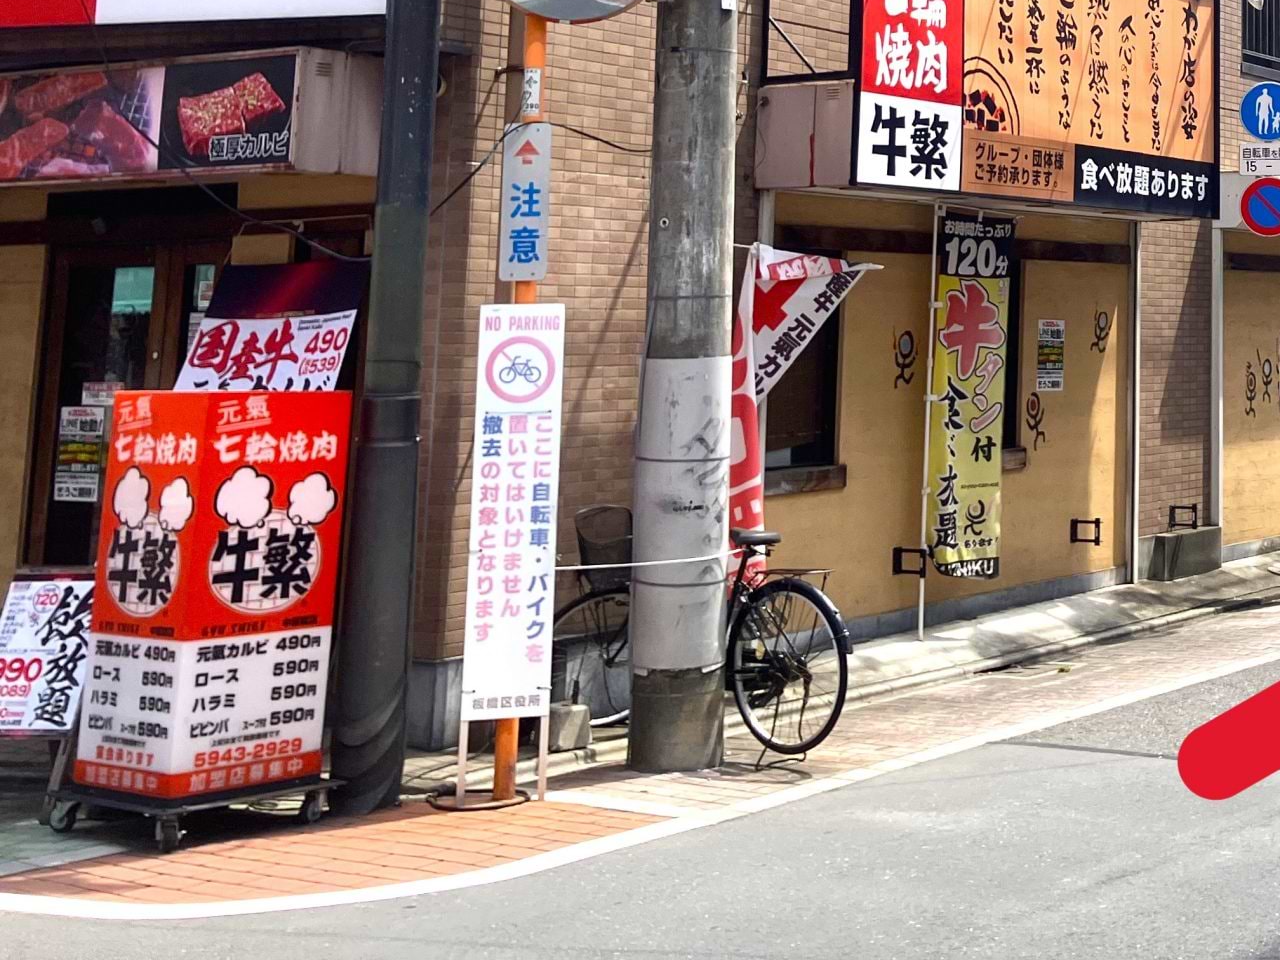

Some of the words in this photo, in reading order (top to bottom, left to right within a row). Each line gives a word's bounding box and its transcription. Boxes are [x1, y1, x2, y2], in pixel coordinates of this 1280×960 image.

[874, 22, 948, 94] 焼肉
[871, 102, 949, 180] 牛繁
[975, 142, 1064, 171] グループ・団体様
[1080, 158, 1209, 202] 食べ放題あります
[1245, 160, 1257, 172] 15
[508, 181, 541, 264] 注意
[945, 237, 1009, 277] 120分
[485, 316, 501, 331] NO
[509, 315, 561, 331] PARKING
[187, 316, 299, 385] 国産牛
[303, 327, 349, 355] 490
[117, 395, 152, 425] 元氣
[217, 393, 271, 427] 元氣
[114, 431, 198, 465] 七輪焼肉
[213, 429, 339, 465] 七輪焼肉
[473, 414, 503, 642] 撤去の対象となります
[500, 414, 528, 618] 置いてはいけません
[524, 414, 554, 663] ここに自転車・バイクを
[108, 526, 177, 606] 牛繁
[211, 527, 316, 604] 牛繁
[33, 593, 59, 607] 120
[144, 645, 176, 663] 490円
[275, 634, 321, 652] 490円
[92, 665, 121, 683] ロース
[141, 671, 173, 689] 590円
[195, 668, 240, 688] ロース
[272, 659, 320, 677] 590円
[90, 689, 118, 707] ハラミ
[138, 696, 171, 714] 590円
[192, 693, 236, 714] ハラミ
[270, 683, 317, 701] 590円
[137, 721, 169, 739] 590円
[269, 707, 315, 726] 590円
[194, 737, 304, 768] 5943-2929
